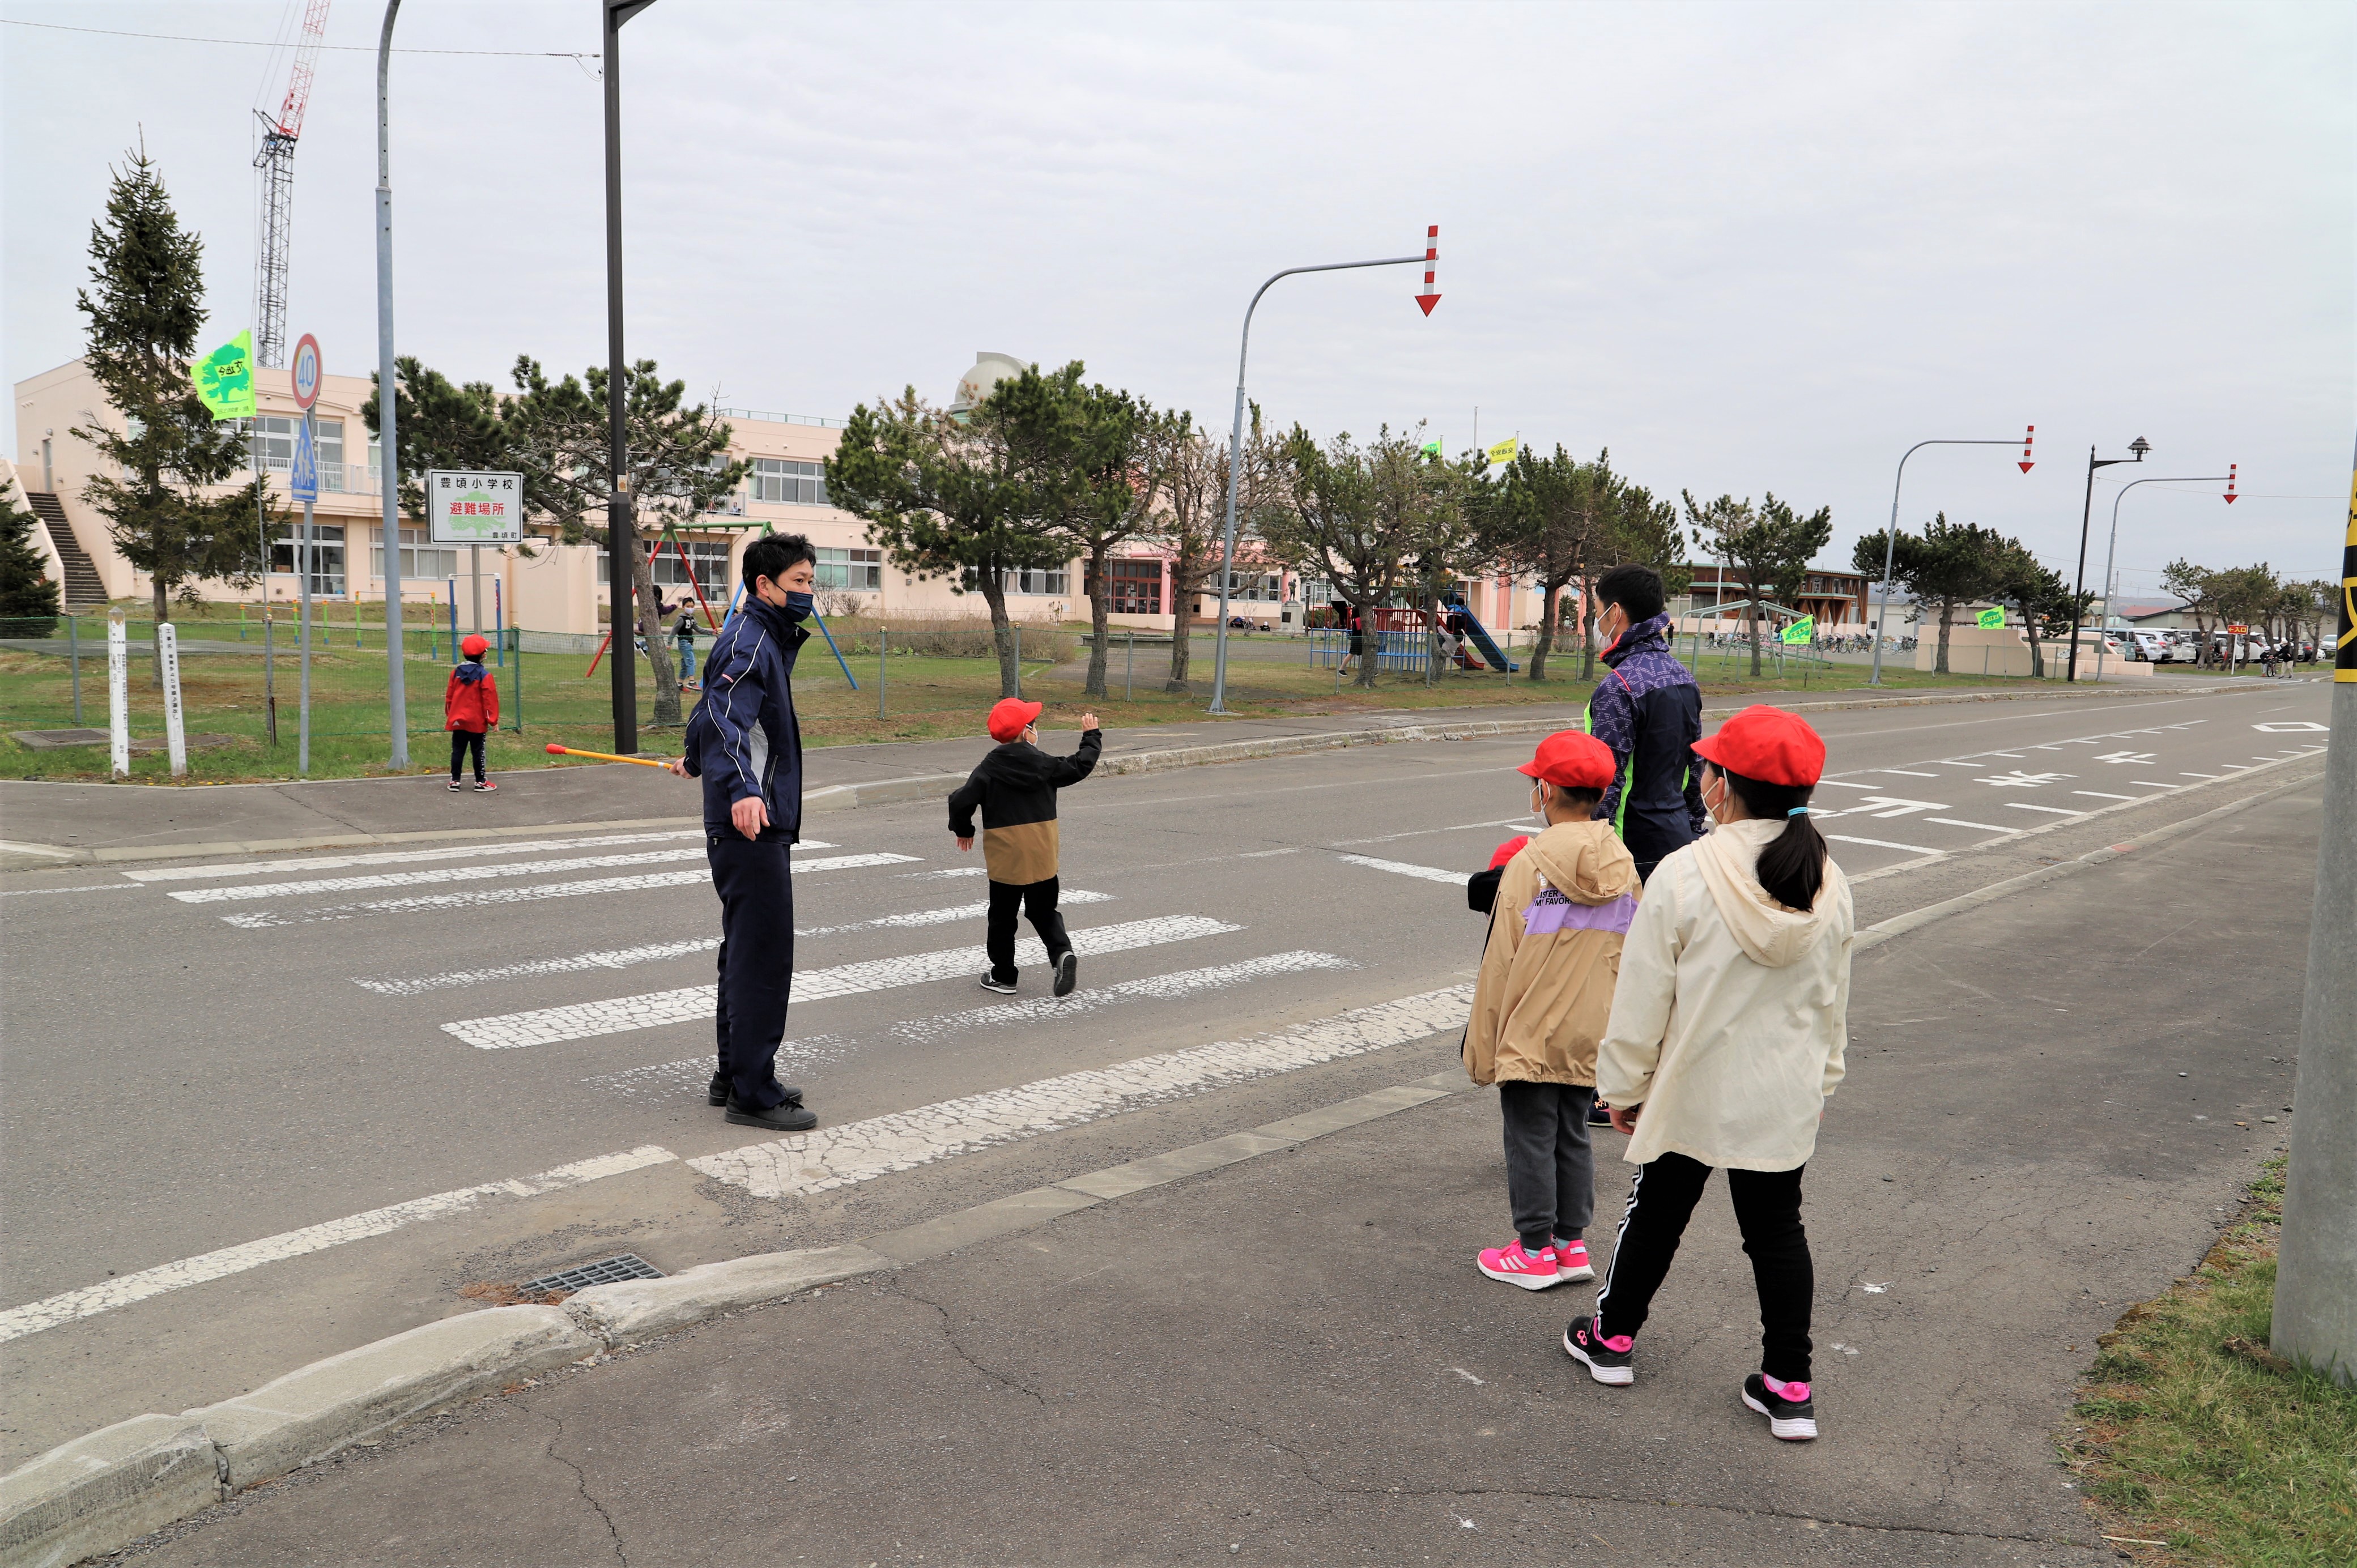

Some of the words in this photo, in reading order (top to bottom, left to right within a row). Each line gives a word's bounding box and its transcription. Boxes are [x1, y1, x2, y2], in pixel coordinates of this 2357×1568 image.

[298, 355, 314, 387] 40
[440, 478, 513, 490] 豊頃小学校
[449, 502, 505, 515] 避難場所
